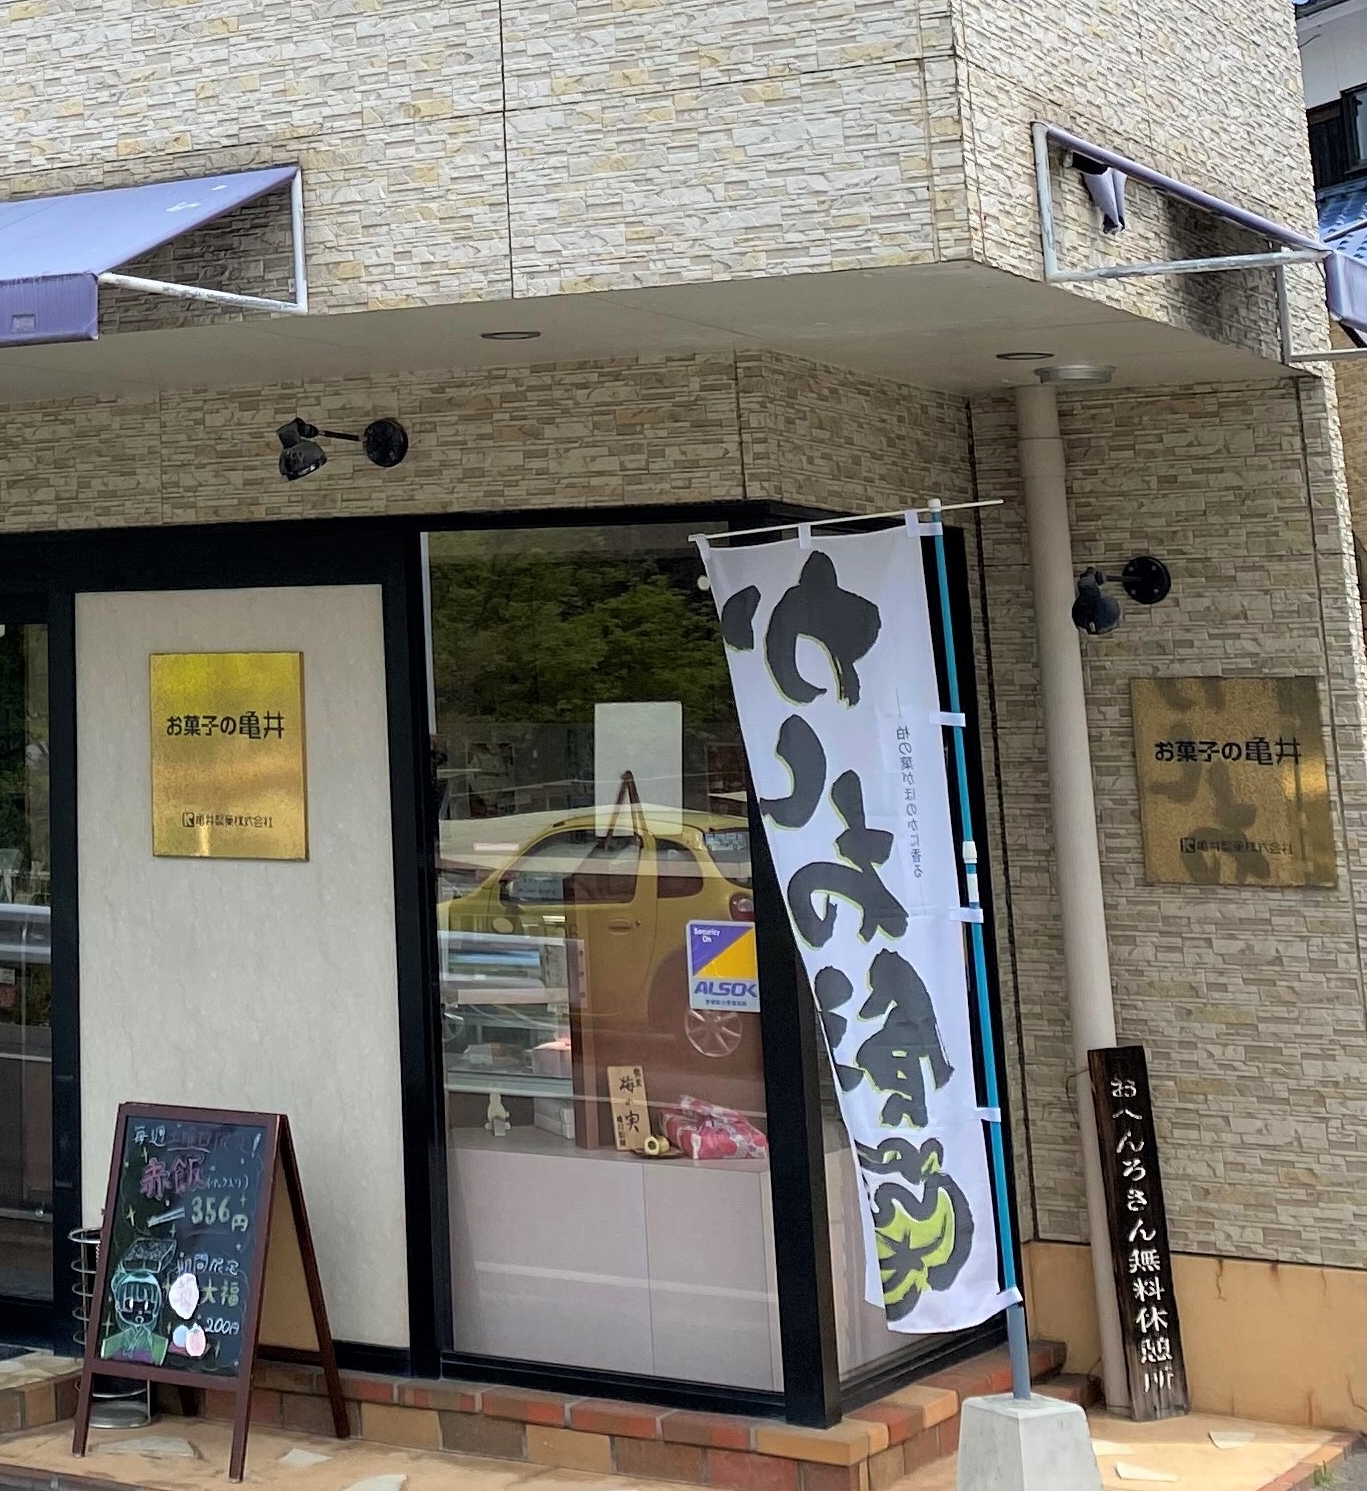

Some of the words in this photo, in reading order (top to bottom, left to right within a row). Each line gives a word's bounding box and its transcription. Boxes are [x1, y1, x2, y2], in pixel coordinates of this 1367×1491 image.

[166, 710, 286, 740] お菓子の亀井
[1154, 736, 1303, 766] お菓子の亀井
[694, 980, 758, 998] ALSOK
[140, 1156, 206, 1202] 赤飯
